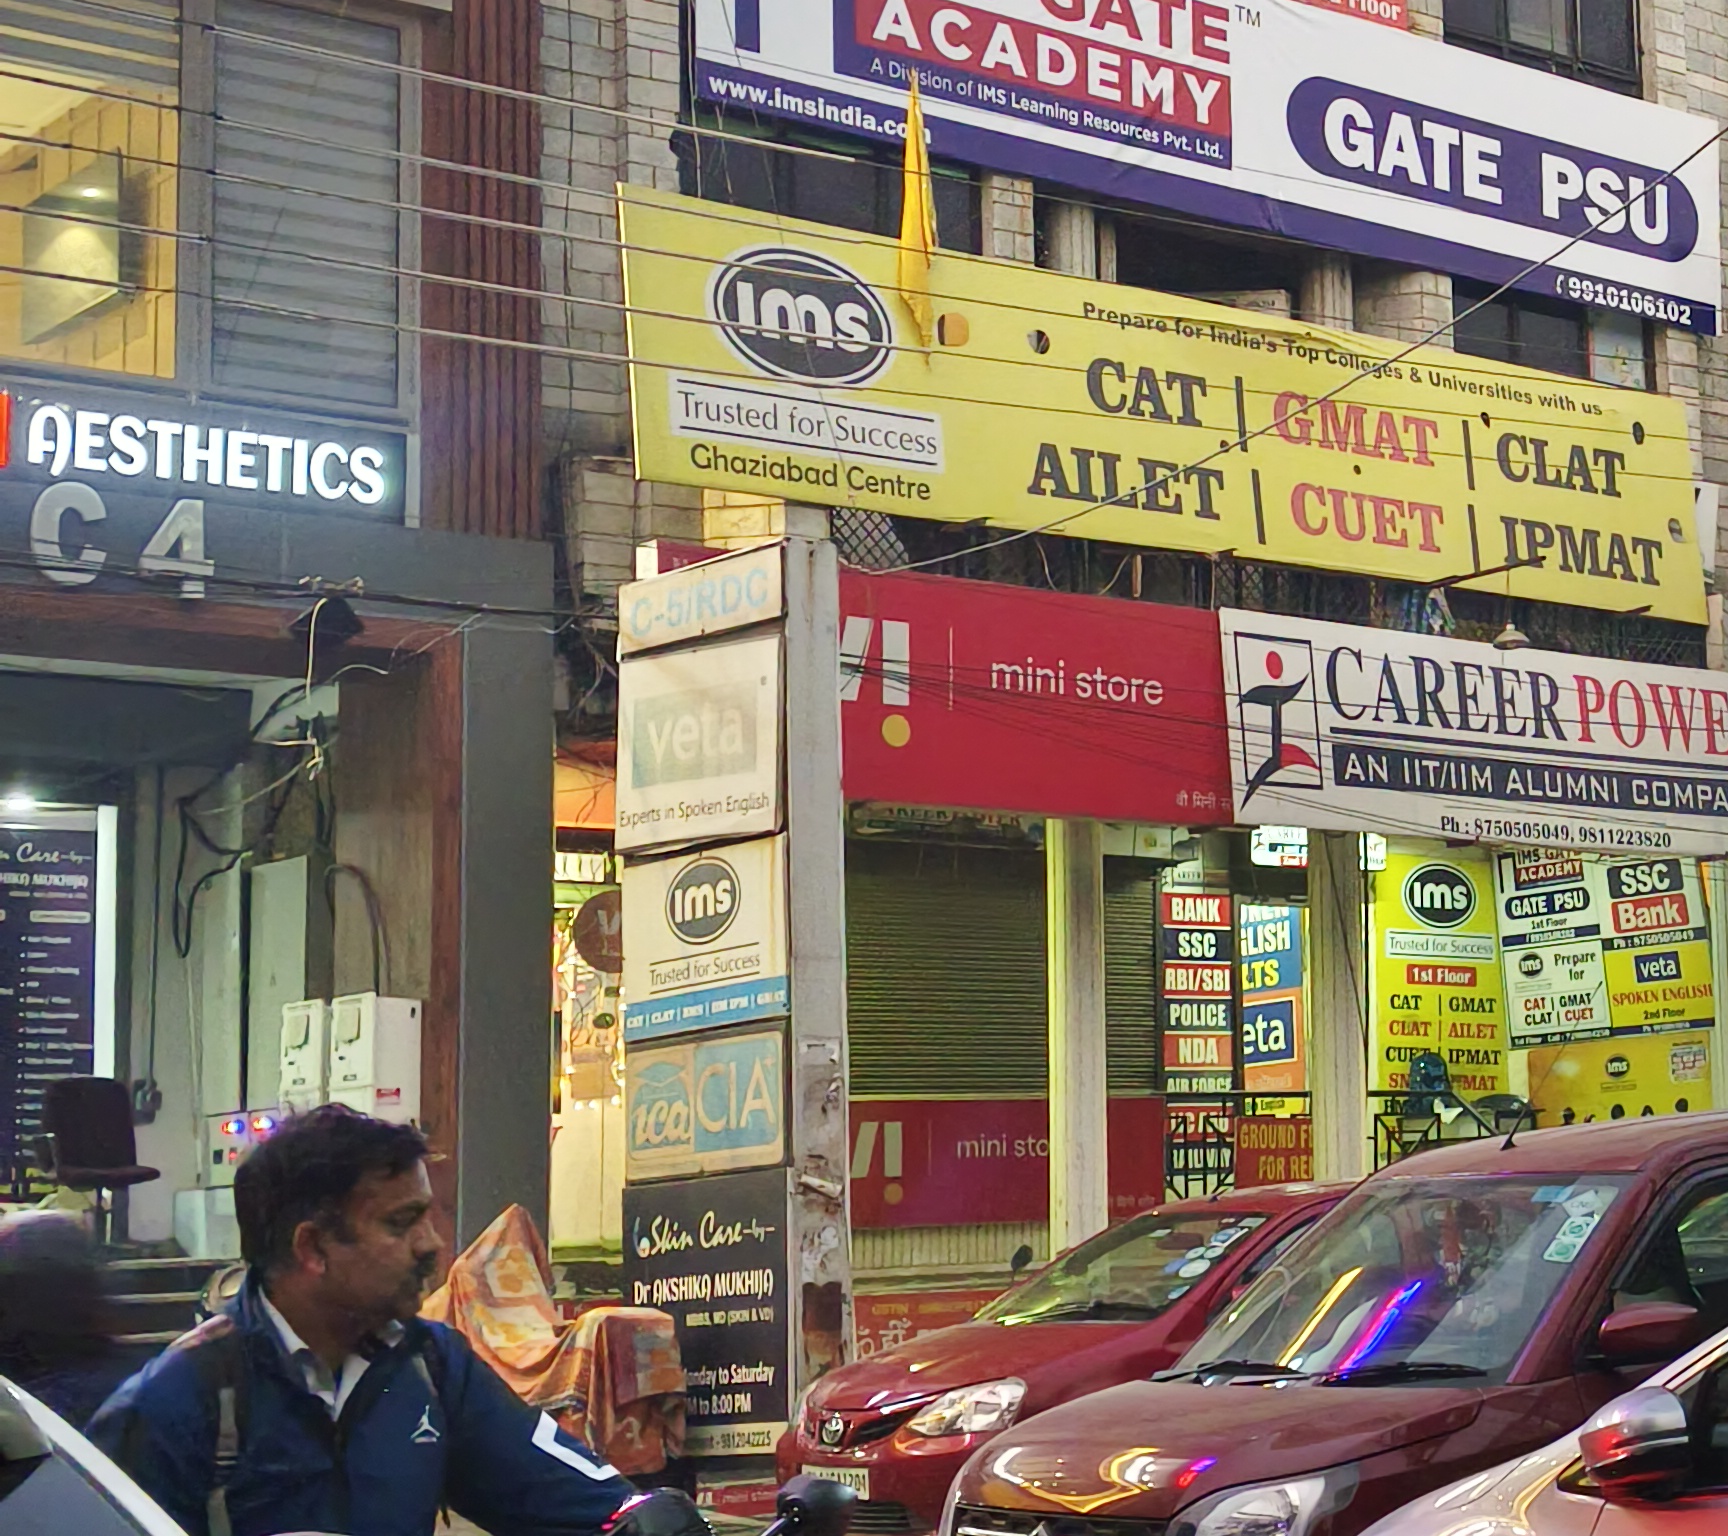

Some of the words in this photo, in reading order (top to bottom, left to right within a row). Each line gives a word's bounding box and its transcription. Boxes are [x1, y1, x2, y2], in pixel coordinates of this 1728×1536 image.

[977, 83, 1007, 106] IMS
[1010, 91, 1079, 127] Learning
[1083, 110, 1159, 144] Resources
[1323, 96, 1503, 205] GATE
[1541, 151, 1669, 246] PSU
[1082, 300, 1168, 338] Prepare
[1173, 318, 1205, 342] for
[1282, 337, 1320, 366] Top
[1537, 390, 1577, 415] with
[1580, 398, 1603, 418] us
[677, 390, 780, 432] Trusted
[787, 407, 826, 437] for
[834, 415, 939, 457] Success
[1086, 356, 1208, 429] CAT
[1271, 390, 1439, 468] GMAT
[1498, 431, 1627, 500] CLAT
[26, 404, 387, 506] AESTHETICS
[690, 443, 839, 488] Ghaziabad
[845, 466, 932, 502] Centre
[1027, 441, 1225, 522] AILET
[1291, 480, 1445, 555] CUET
[1498, 514, 1664, 589] IPMAT
[138, 498, 216, 599] 4
[990, 656, 1065, 696] mini
[1074, 667, 1164, 706] store
[1325, 645, 1568, 744] CAREER
[647, 708, 744, 763] veta
[1343, 751, 1389, 787] AN
[1402, 758, 1494, 795] IIT/IIM
[1504, 767, 1621, 805] ALUMNI
[619, 805, 662, 829] Experts
[663, 803, 675, 820] in
[678, 797, 722, 822] Spoken
[724, 792, 770, 814] English
[1578, 824, 1673, 851] 9811223820
[1620, 863, 1670, 895] SSC
[1170, 897, 1221, 923] BANK
[1511, 895, 1548, 917] GATE
[1553, 889, 1585, 912] PSU
[1616, 899, 1682, 931] Bank
[1177, 933, 1217, 958] SSC
[1164, 968, 1231, 993] RBI/SBI
[1639, 957, 1678, 979] veta
[1169, 1003, 1228, 1028] POLICE
[1390, 994, 1422, 1011] CAT
[1448, 996, 1498, 1015] GMAT
[1177, 1037, 1219, 1065] NDA
[695, 1054, 776, 1135] CIA
[956, 1133, 1008, 1160] mini
[1240, 1126, 1296, 1149] GROUND
[1258, 1153, 1286, 1181] FOR
[649, 1214, 694, 1257] Skin
[699, 1210, 744, 1250] Care
[633, 1279, 651, 1306] Dr
[652, 1273, 712, 1307] AKSHIKA
[713, 1268, 775, 1301] MUKHIJA
[730, 1360, 776, 1387] Saturday
